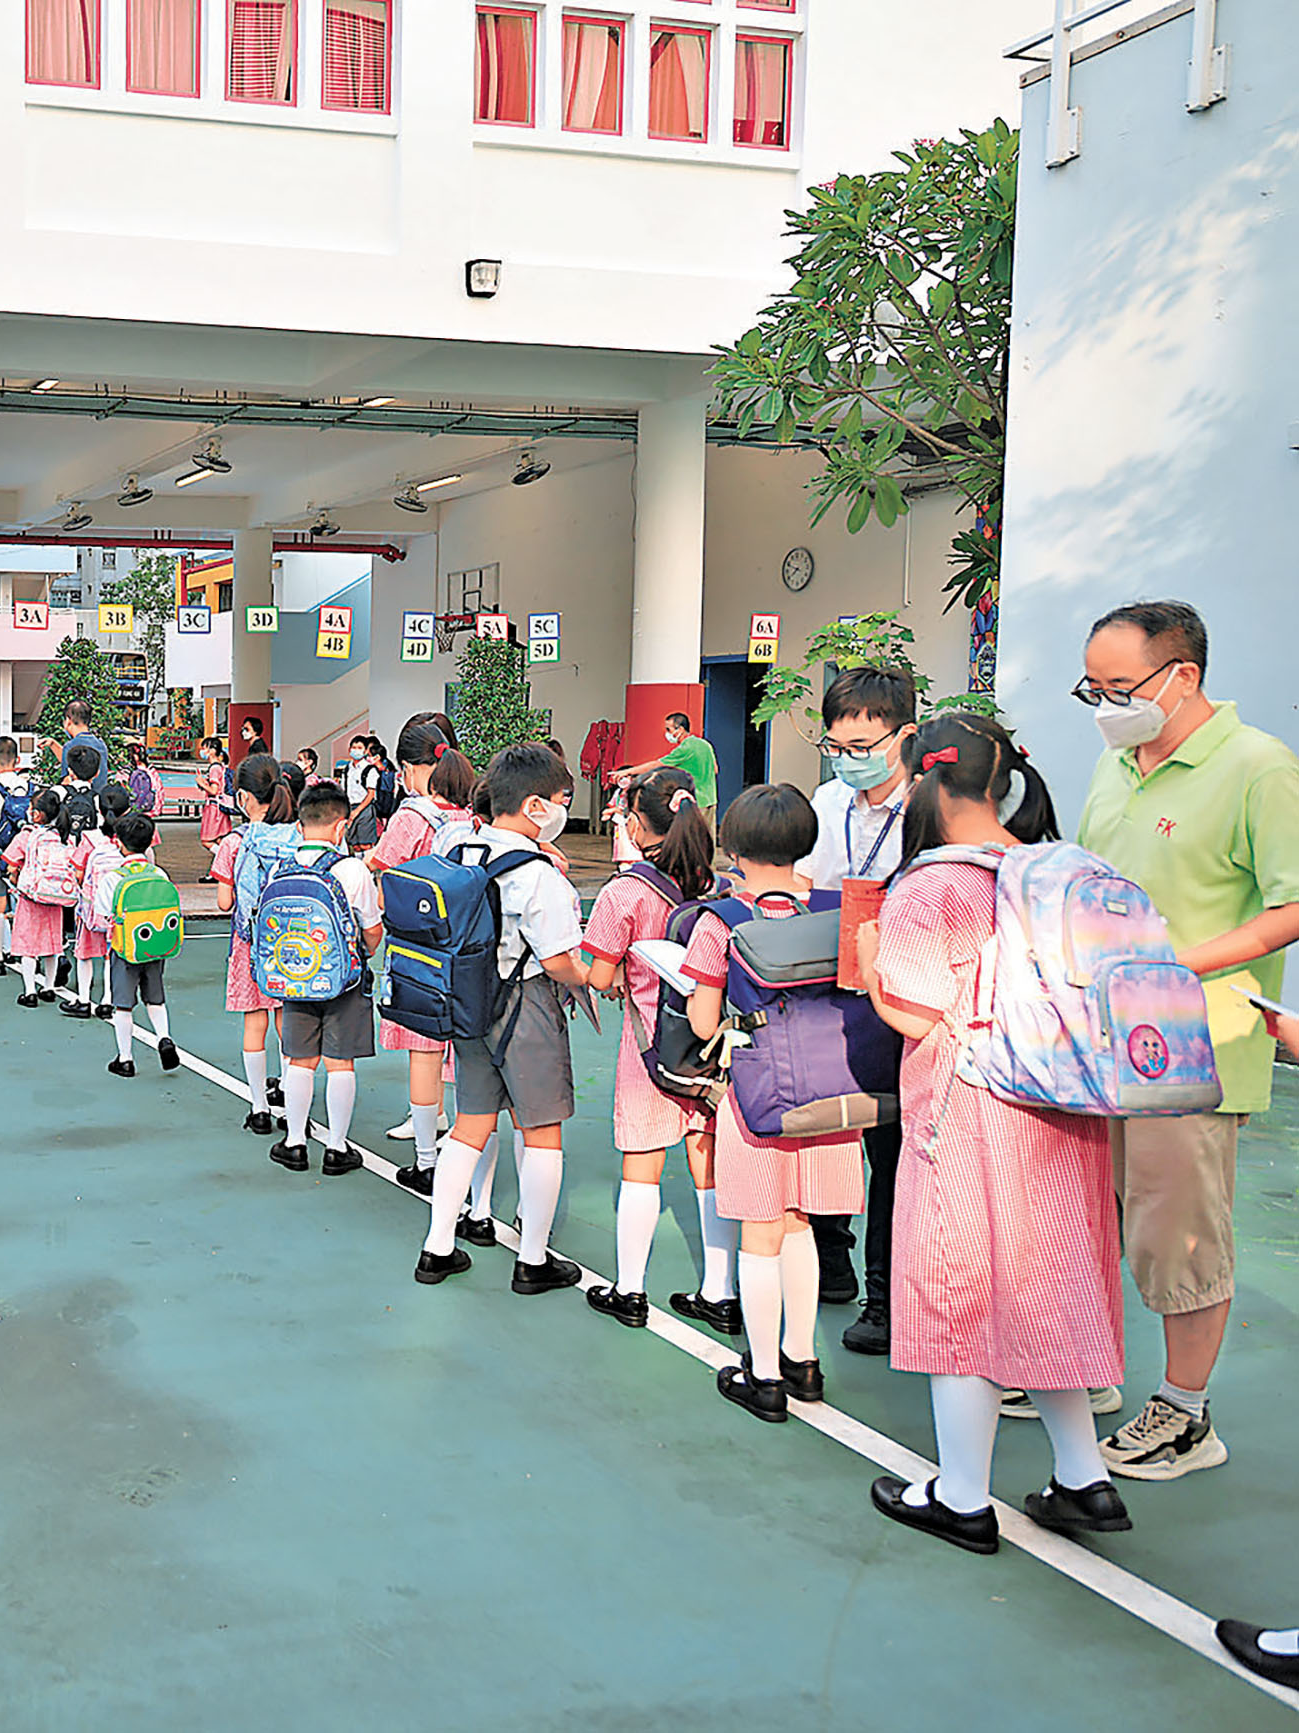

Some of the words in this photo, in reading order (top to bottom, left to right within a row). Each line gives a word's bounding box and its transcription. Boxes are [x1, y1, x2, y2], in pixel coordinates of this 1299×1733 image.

[19, 607, 43, 625] 3A
[105, 610, 127, 627] 3B
[183, 611, 206, 628] 3C
[251, 611, 274, 627] 3D
[324, 613, 348, 629] 4A
[408, 618, 430, 634] 4C
[483, 620, 503, 635] 5A
[534, 619, 555, 634] 5C
[756, 619, 775, 635] 6A
[322, 637, 345, 653] 4B
[406, 642, 428, 657] 4D
[534, 642, 554, 658] 5D
[754, 643, 773, 658] 6B
[1155, 817, 1177, 838] FK
